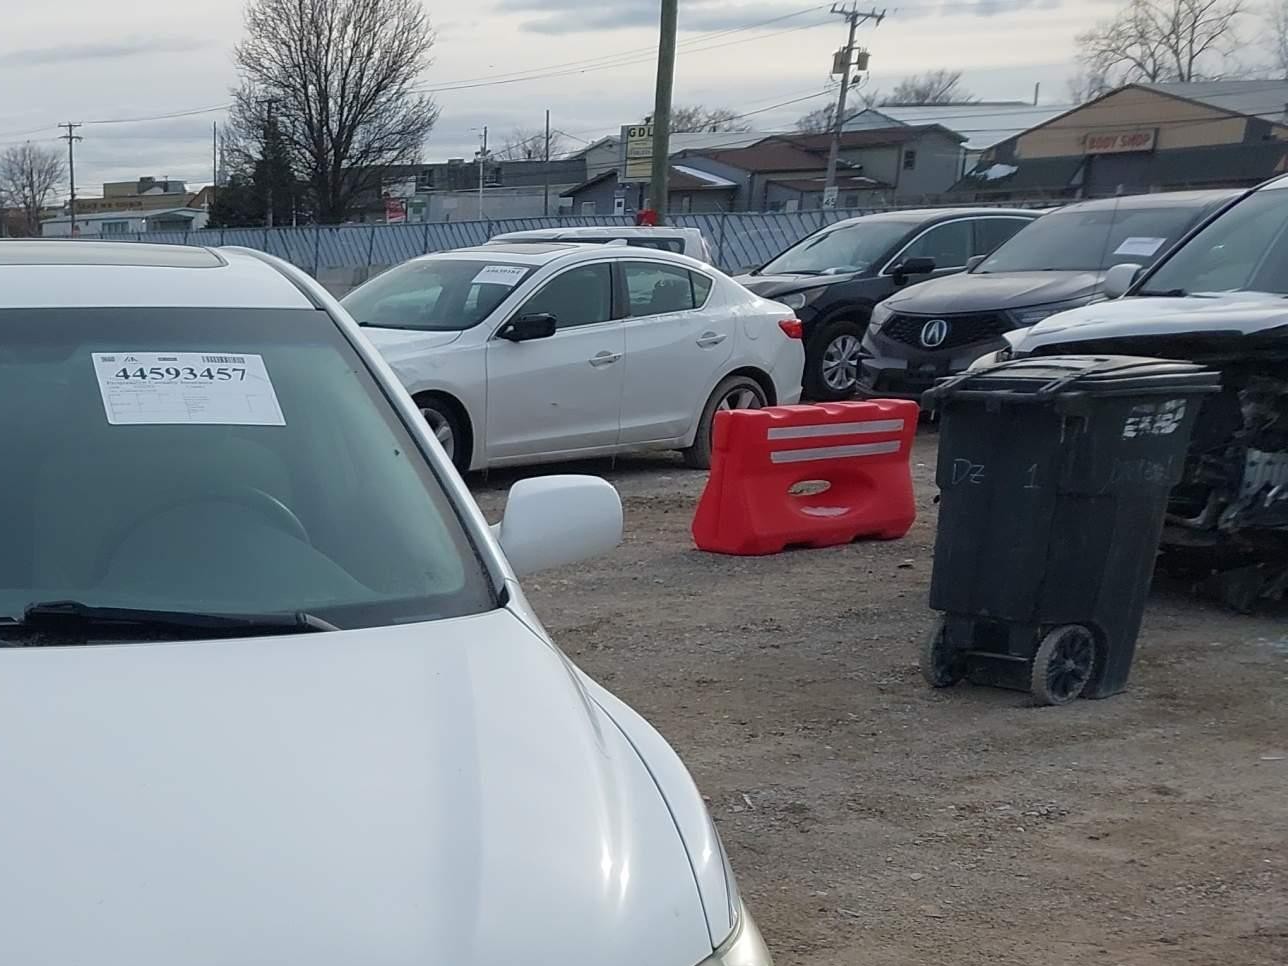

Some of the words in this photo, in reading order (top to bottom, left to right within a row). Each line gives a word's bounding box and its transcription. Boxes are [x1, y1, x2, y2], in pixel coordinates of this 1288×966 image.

[1088, 135, 1119, 150] BODY
[1119, 133, 1151, 147] SHOP
[115, 367, 245, 381] 44593457
